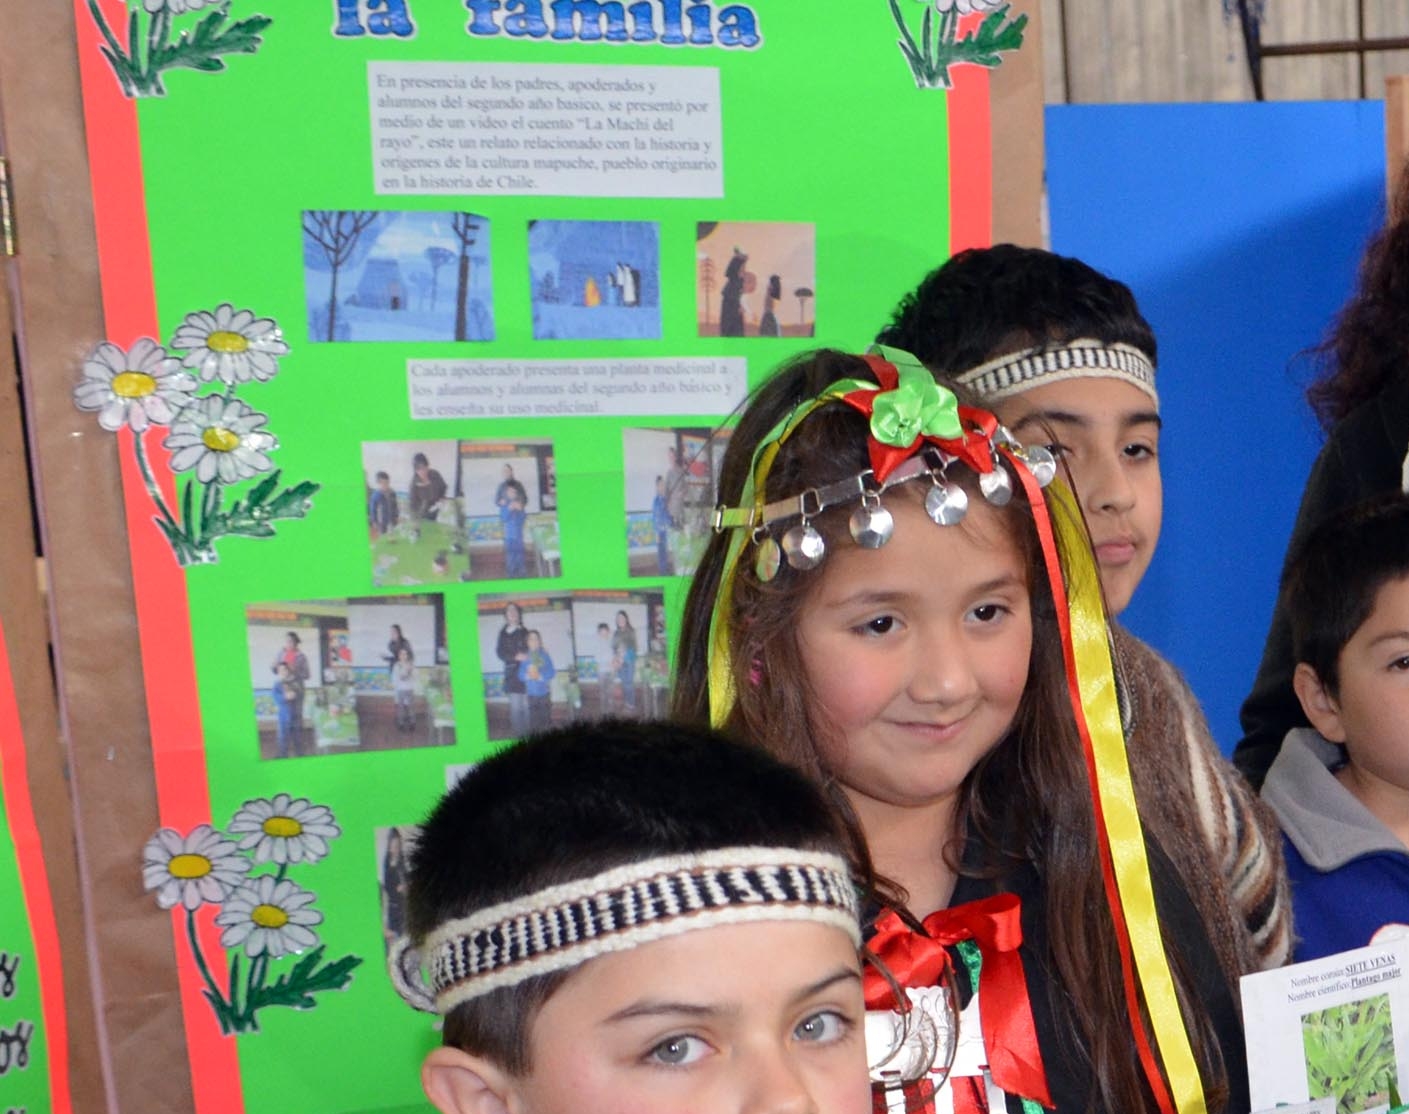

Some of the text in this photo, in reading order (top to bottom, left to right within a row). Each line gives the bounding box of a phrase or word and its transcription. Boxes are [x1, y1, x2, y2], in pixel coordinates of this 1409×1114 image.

[376, 74, 656, 95] En presencia de los padres, apoderados y
[377, 95, 437, 109] alumnos
[441, 96, 463, 109] del
[467, 97, 525, 112] segundo
[608, 102, 622, 111] se
[686, 102, 708, 116] por
[378, 115, 423, 129] medio
[427, 115, 443, 129] de
[447, 120, 465, 130] un
[469, 116, 508, 130] video
[511, 116, 524, 130] el
[528, 119, 574, 130] cuento
[606, 118, 650, 131] Machi
[653, 118, 674, 131] del
[427, 138, 454, 149] este
[459, 139, 476, 149] un
[480, 136, 520, 150] relato
[523, 136, 602, 150] relacionado
[605, 139, 630, 150] con
[634, 137, 646, 150] la
[650, 137, 700, 151] historia
[445, 156, 463, 169] de
[465, 156, 478, 169] la
[482, 156, 530, 169] cultura
[534, 156, 599, 172] mapuche,
[602, 157, 648, 172] pueblo
[651, 157, 717, 173] originario
[383, 174, 539, 189] en la historia de Chile.
[411, 364, 446, 377] Cada
[610, 362, 649, 378] planta
[654, 362, 716, 375] medicinal
[1291, 975, 1320, 988] Nombre
[1370, 953, 1397, 970] VENAS
[1287, 991, 1317, 1003] Nombre
